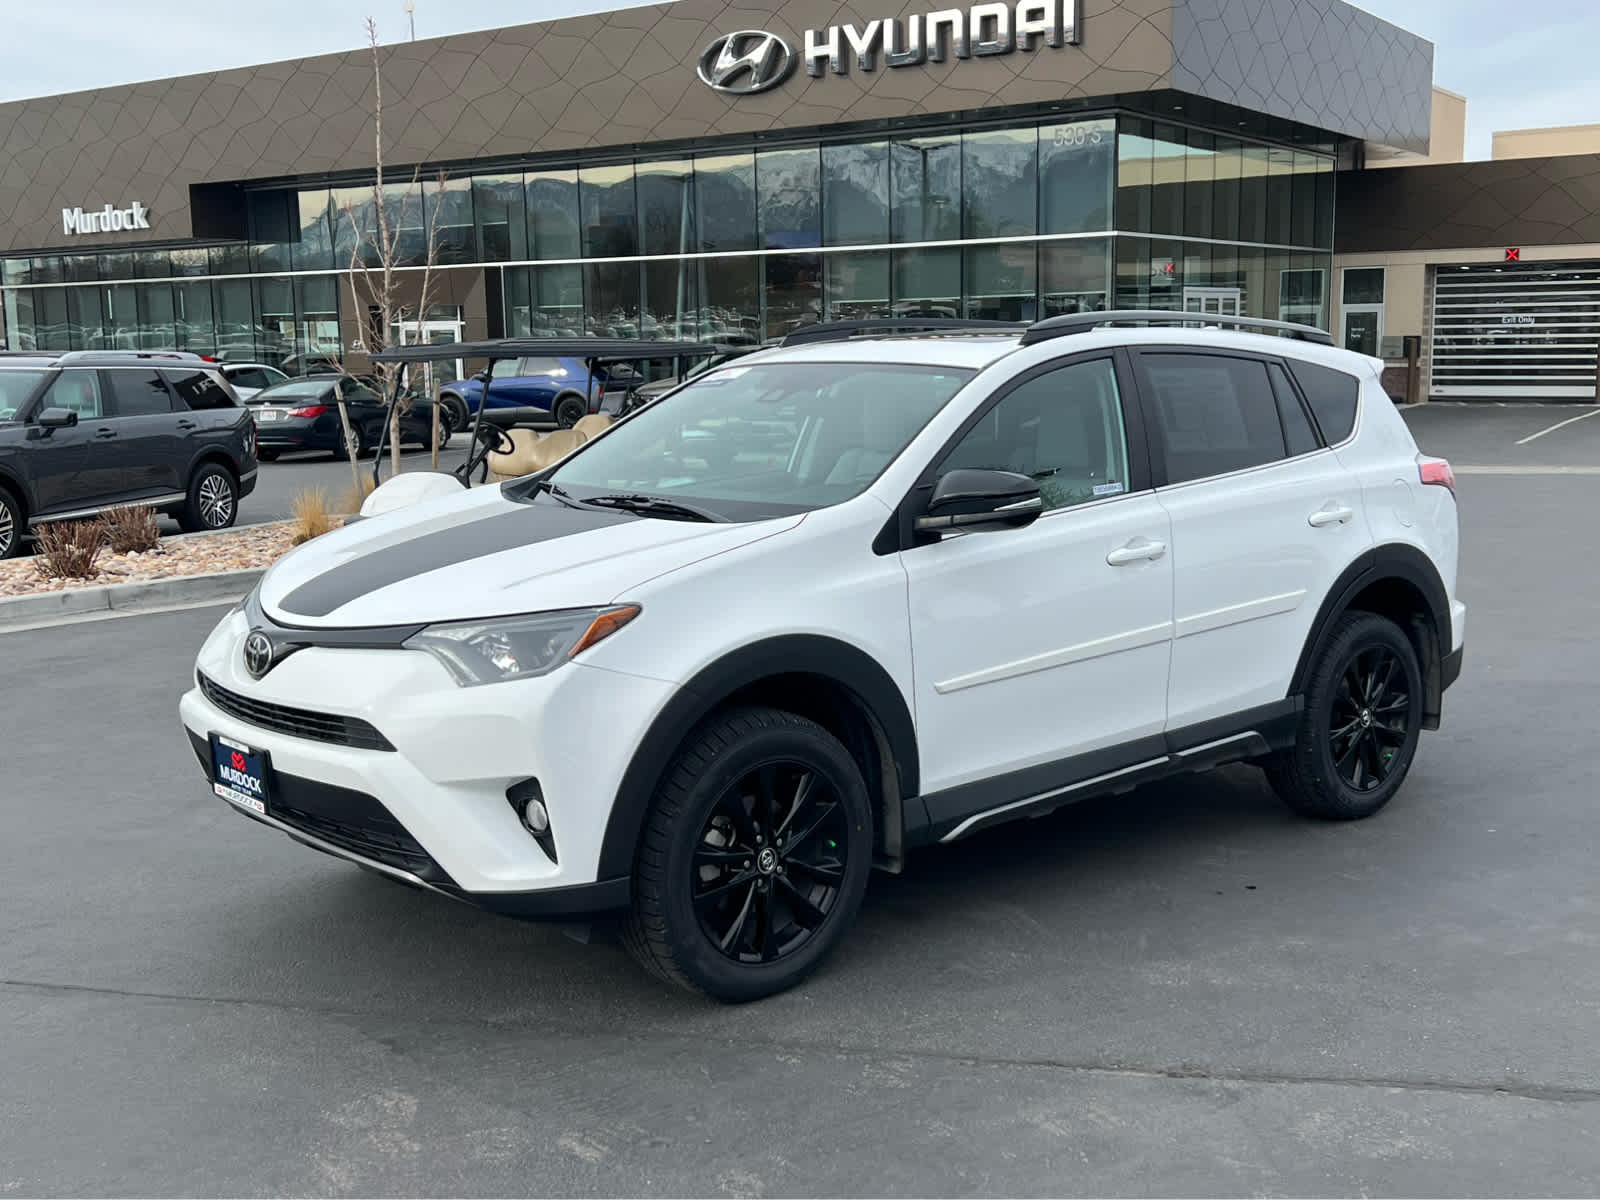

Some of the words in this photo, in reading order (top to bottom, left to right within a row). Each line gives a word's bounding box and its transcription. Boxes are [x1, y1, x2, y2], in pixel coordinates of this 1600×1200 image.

[804, 0, 1080, 77] HYUNDAI
[62, 201, 150, 235] Murdock
[1518, 314, 1536, 325] Only
[220, 764, 262, 793] MURDOCK
